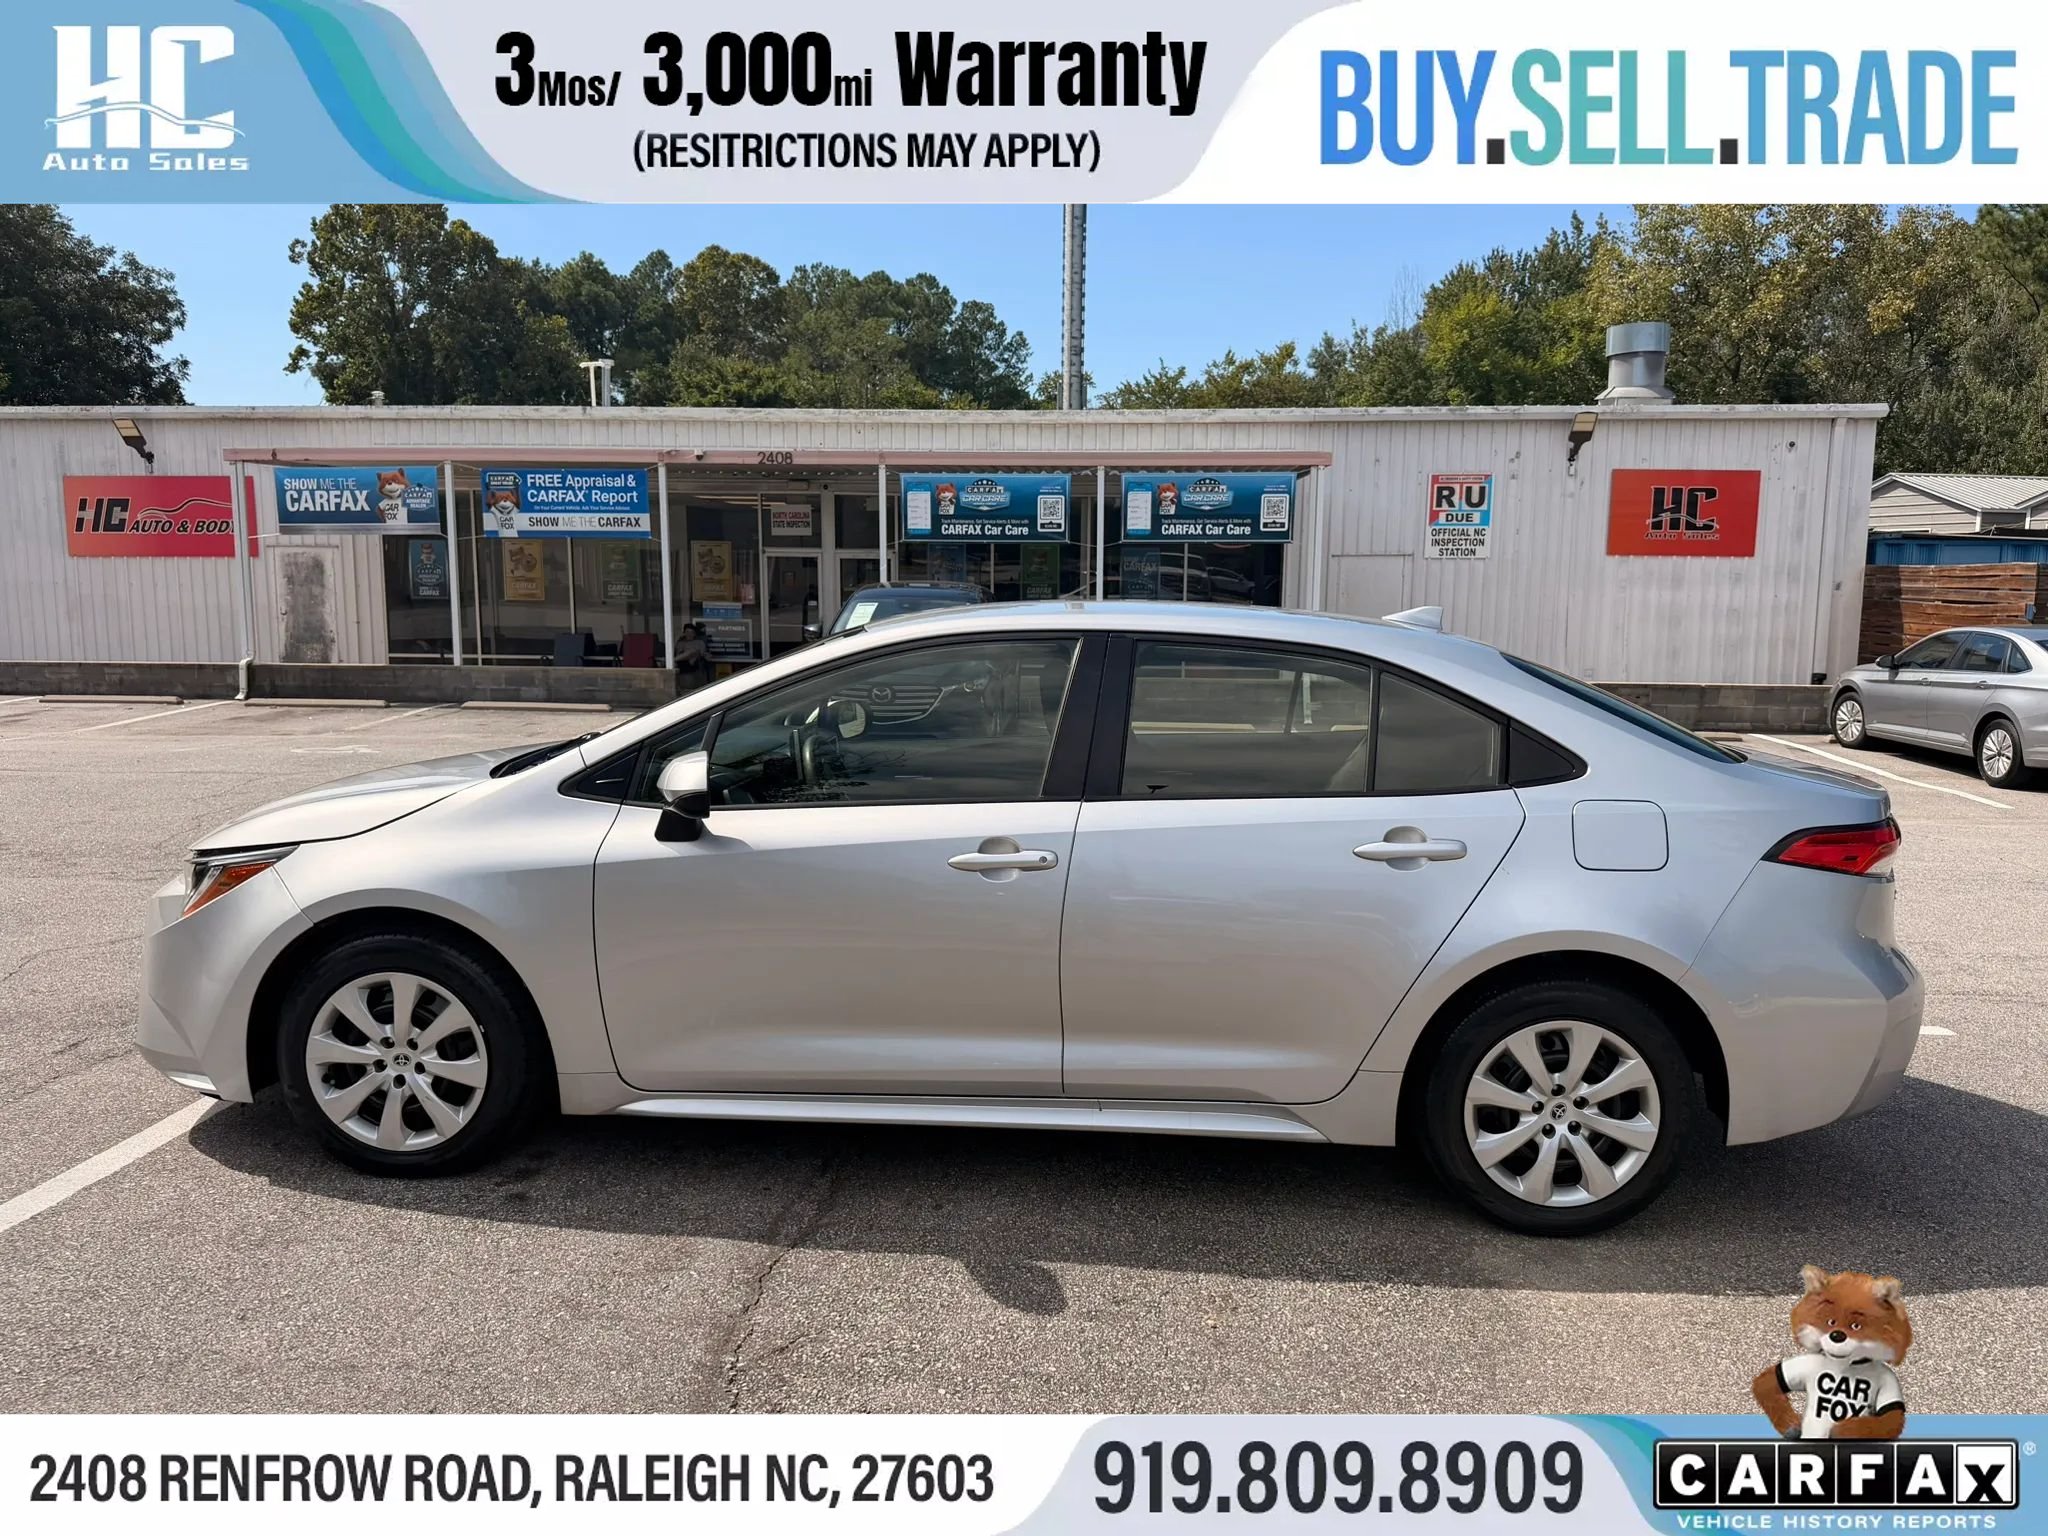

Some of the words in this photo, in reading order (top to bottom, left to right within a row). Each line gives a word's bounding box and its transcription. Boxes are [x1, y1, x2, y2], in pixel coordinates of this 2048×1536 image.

[757, 451, 793, 465] 2408
[284, 478, 317, 490] SHOW
[320, 478, 335, 490] ME
[337, 478, 357, 490] THE
[527, 474, 562, 487] FREE
[565, 474, 624, 490] Appraisal
[627, 475, 636, 487] &
[285, 490, 371, 512] CARFAX
[527, 490, 586, 503] CARFAX
[592, 490, 638, 505] Report
[1435, 485, 1456, 509] R
[1465, 485, 1486, 509] U
[75, 497, 131, 534] HC
[1649, 486, 1719, 532] HC
[528, 516, 559, 527] SHOW
[562, 517, 576, 527] ME
[579, 517, 596, 527] THE
[598, 516, 641, 528] CARFAX
[1445, 513, 1474, 523] DUE
[129, 519, 173, 533] AUTO
[177, 519, 190, 533] &
[941, 524, 982, 535] CARFAX
[984, 524, 1003, 535] Car
[1005, 524, 1029, 535] Care
[1161, 524, 1203, 535] CARFAX
[1205, 524, 1224, 535] Car
[1226, 524, 1251, 535] Care
[1431, 528, 1471, 537] OFFICIAL
[1473, 528, 1486, 537] NC
[1431, 538, 1485, 547] INSPECTION
[1438, 548, 1477, 557] STATION
